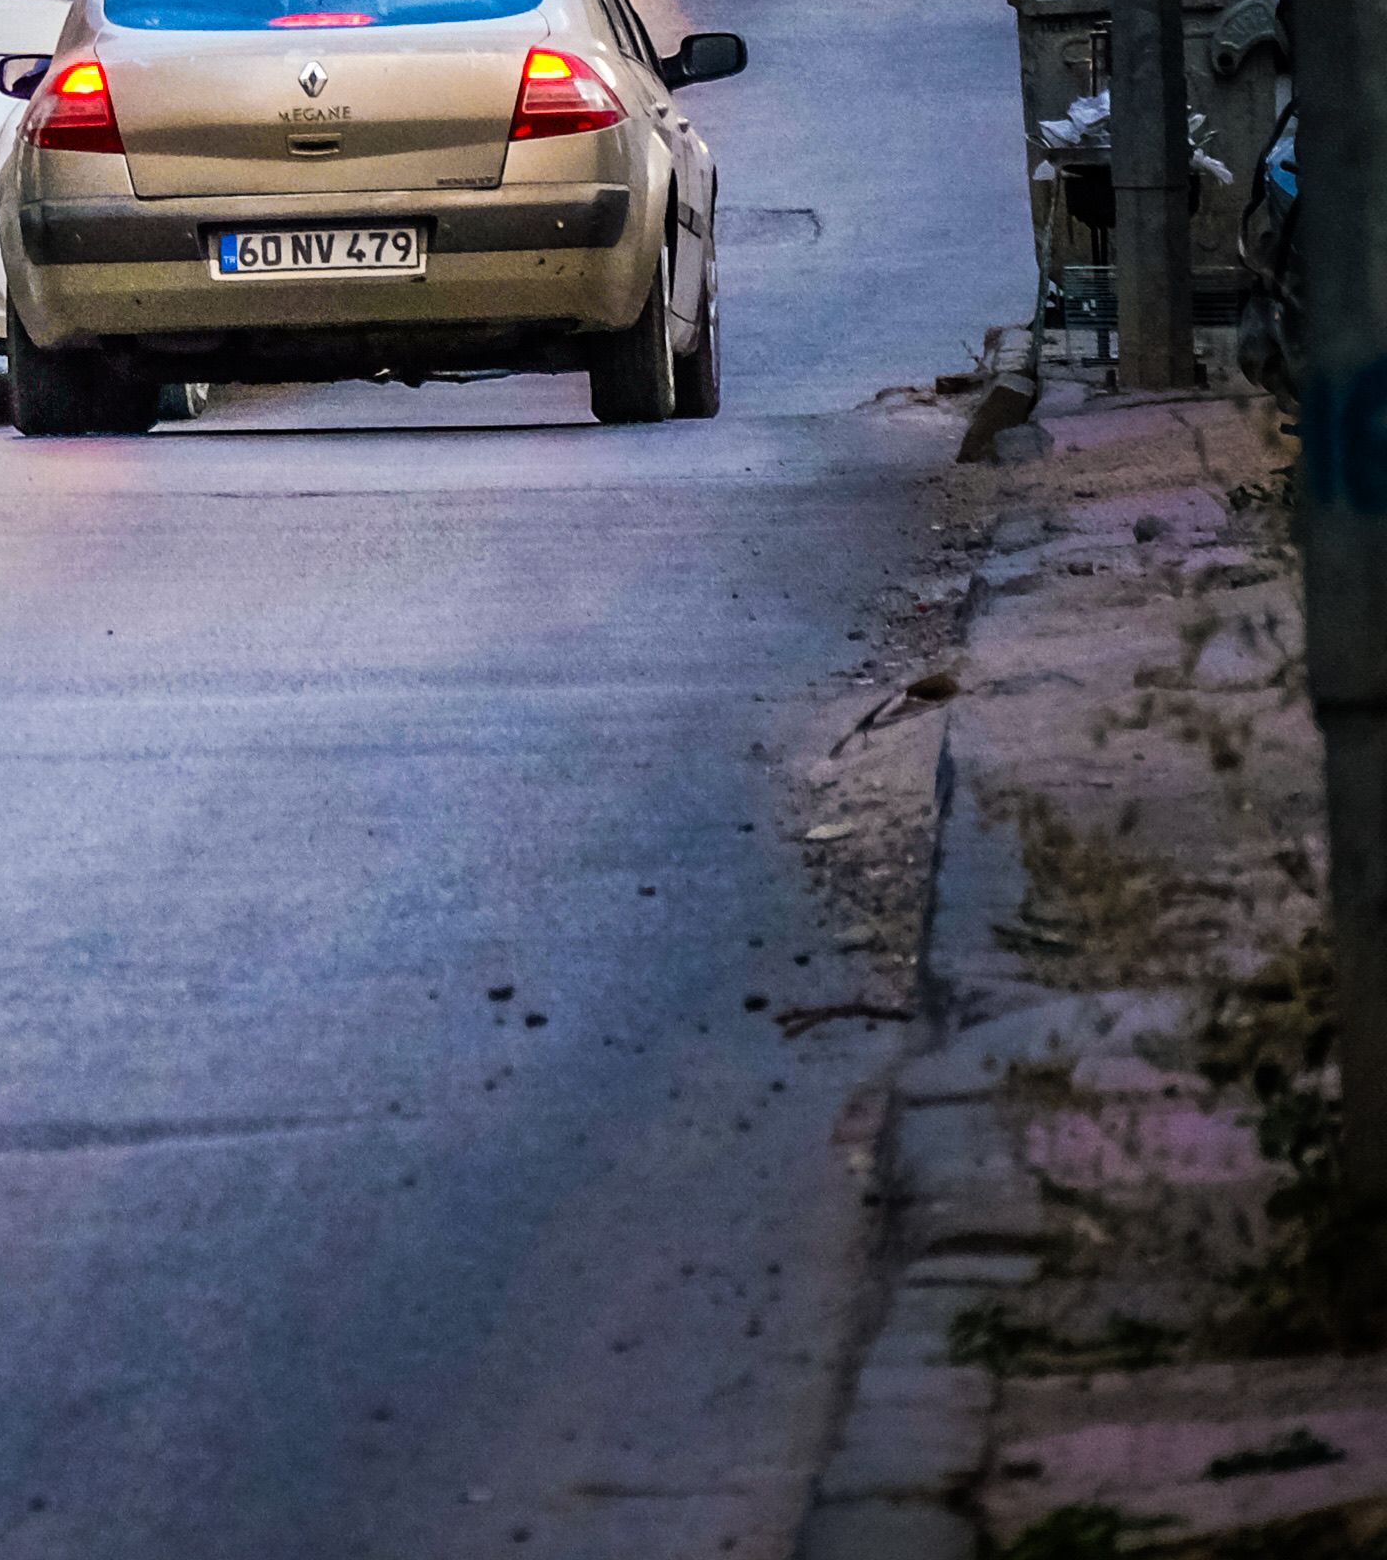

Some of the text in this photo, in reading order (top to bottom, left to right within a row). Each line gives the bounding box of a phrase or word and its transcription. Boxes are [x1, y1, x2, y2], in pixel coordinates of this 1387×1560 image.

[278, 106, 352, 122] MEGANE
[239, 235, 282, 267] 60
[291, 233, 335, 265] NV
[346, 231, 413, 262] 479
